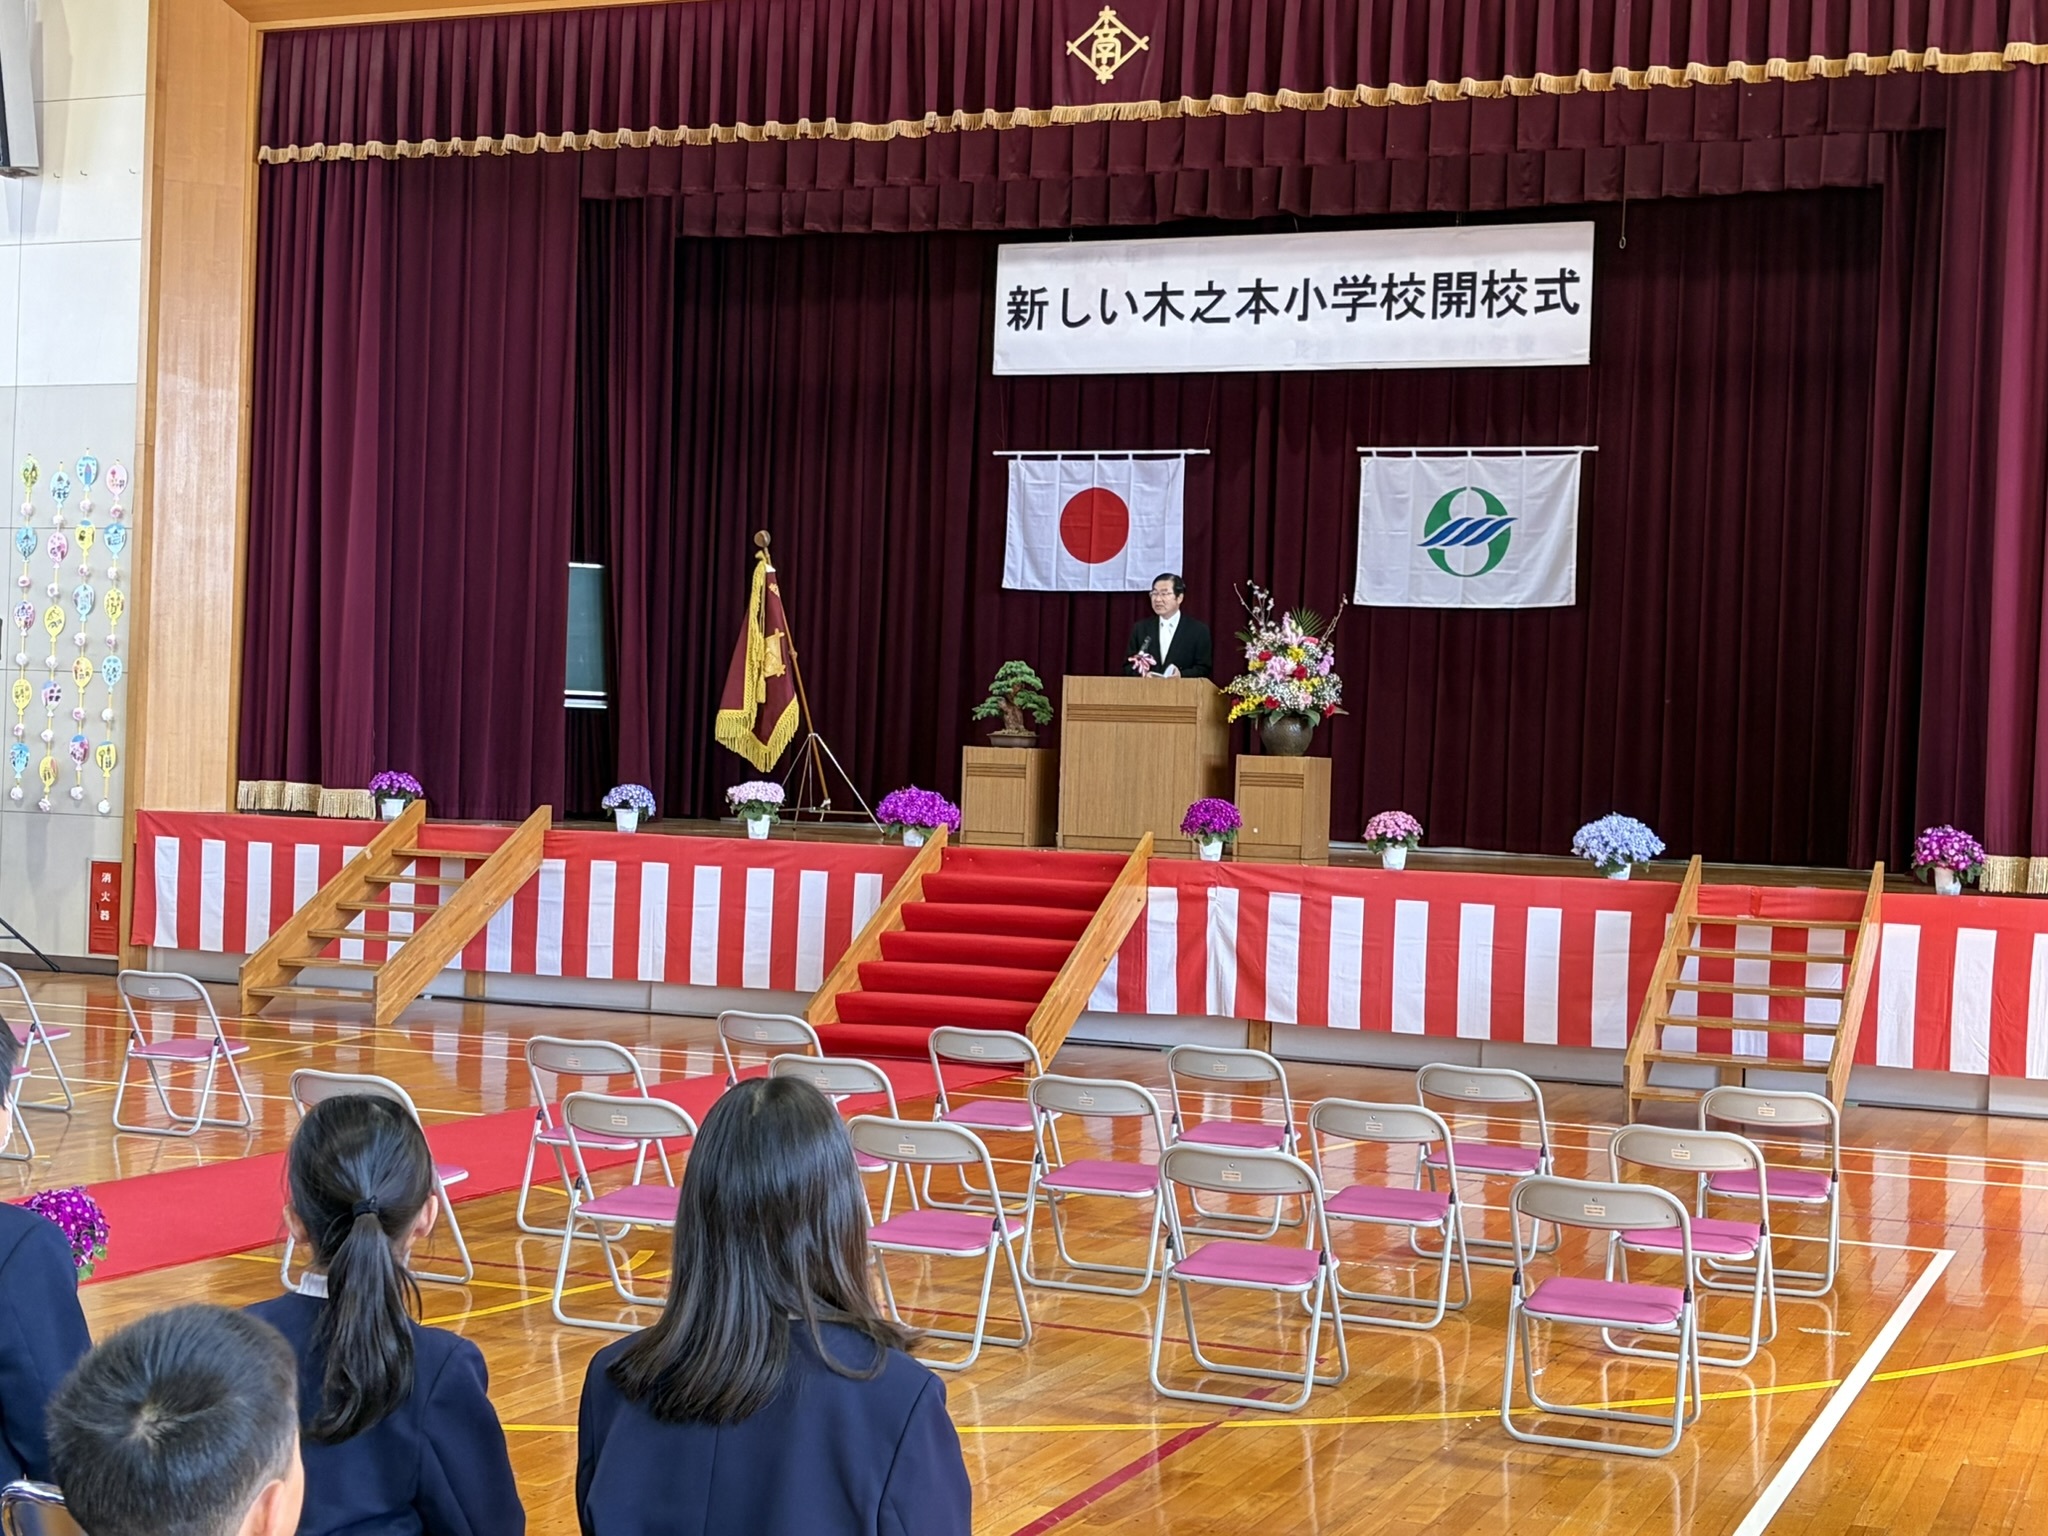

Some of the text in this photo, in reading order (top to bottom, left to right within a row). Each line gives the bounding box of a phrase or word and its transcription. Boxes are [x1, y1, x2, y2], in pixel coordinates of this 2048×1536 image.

[1007, 267, 1580, 331] 新しい木之本小学校開校式
[100, 872, 112, 921] 消火器
